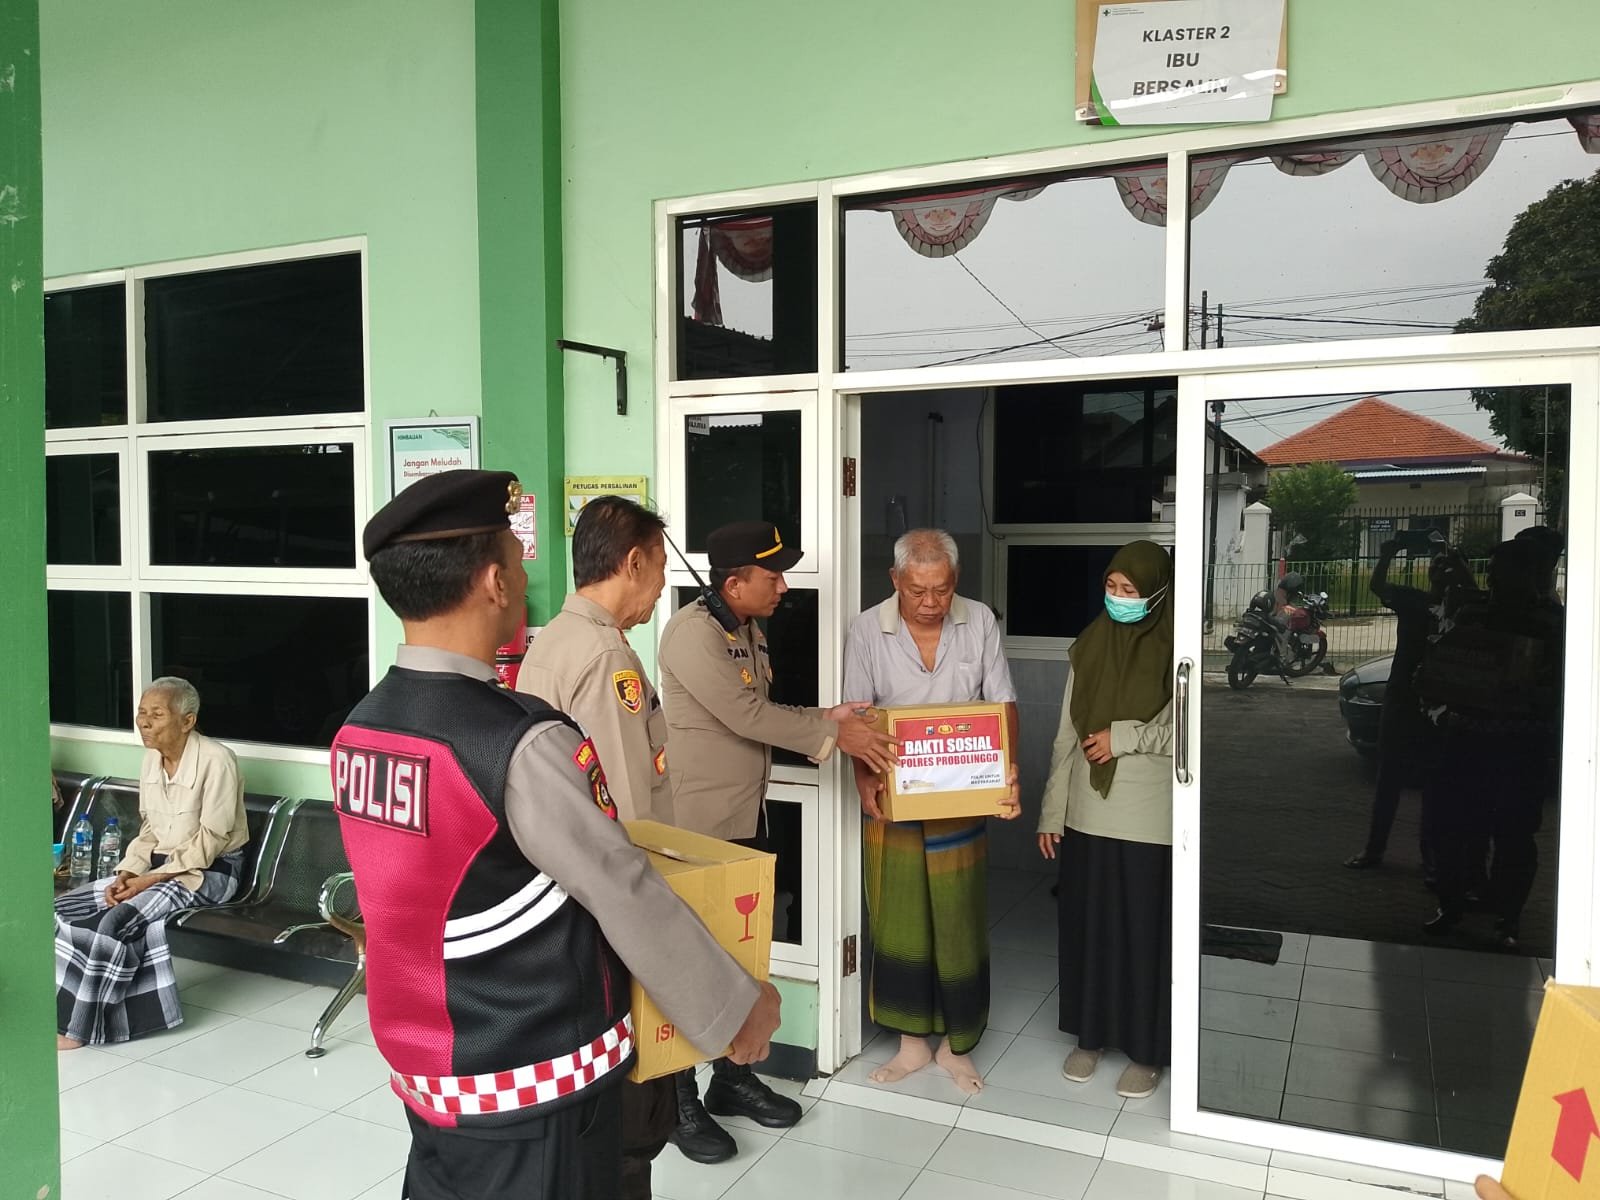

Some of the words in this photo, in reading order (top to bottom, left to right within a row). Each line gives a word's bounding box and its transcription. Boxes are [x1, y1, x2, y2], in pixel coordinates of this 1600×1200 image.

[1143, 27, 1217, 42] KLASTER
[1221, 26, 1231, 39] 2
[1166, 53, 1200, 67] IBU
[403, 459, 429, 469] Jangan
[431, 457, 462, 466] Meludah
[904, 739, 944, 755] BAKTI
[946, 736, 993, 752] SOSIAL
[901, 757, 934, 768] POLRES
[936, 753, 999, 766] PROBOLINGGO
[336, 749, 421, 829] POLISI
